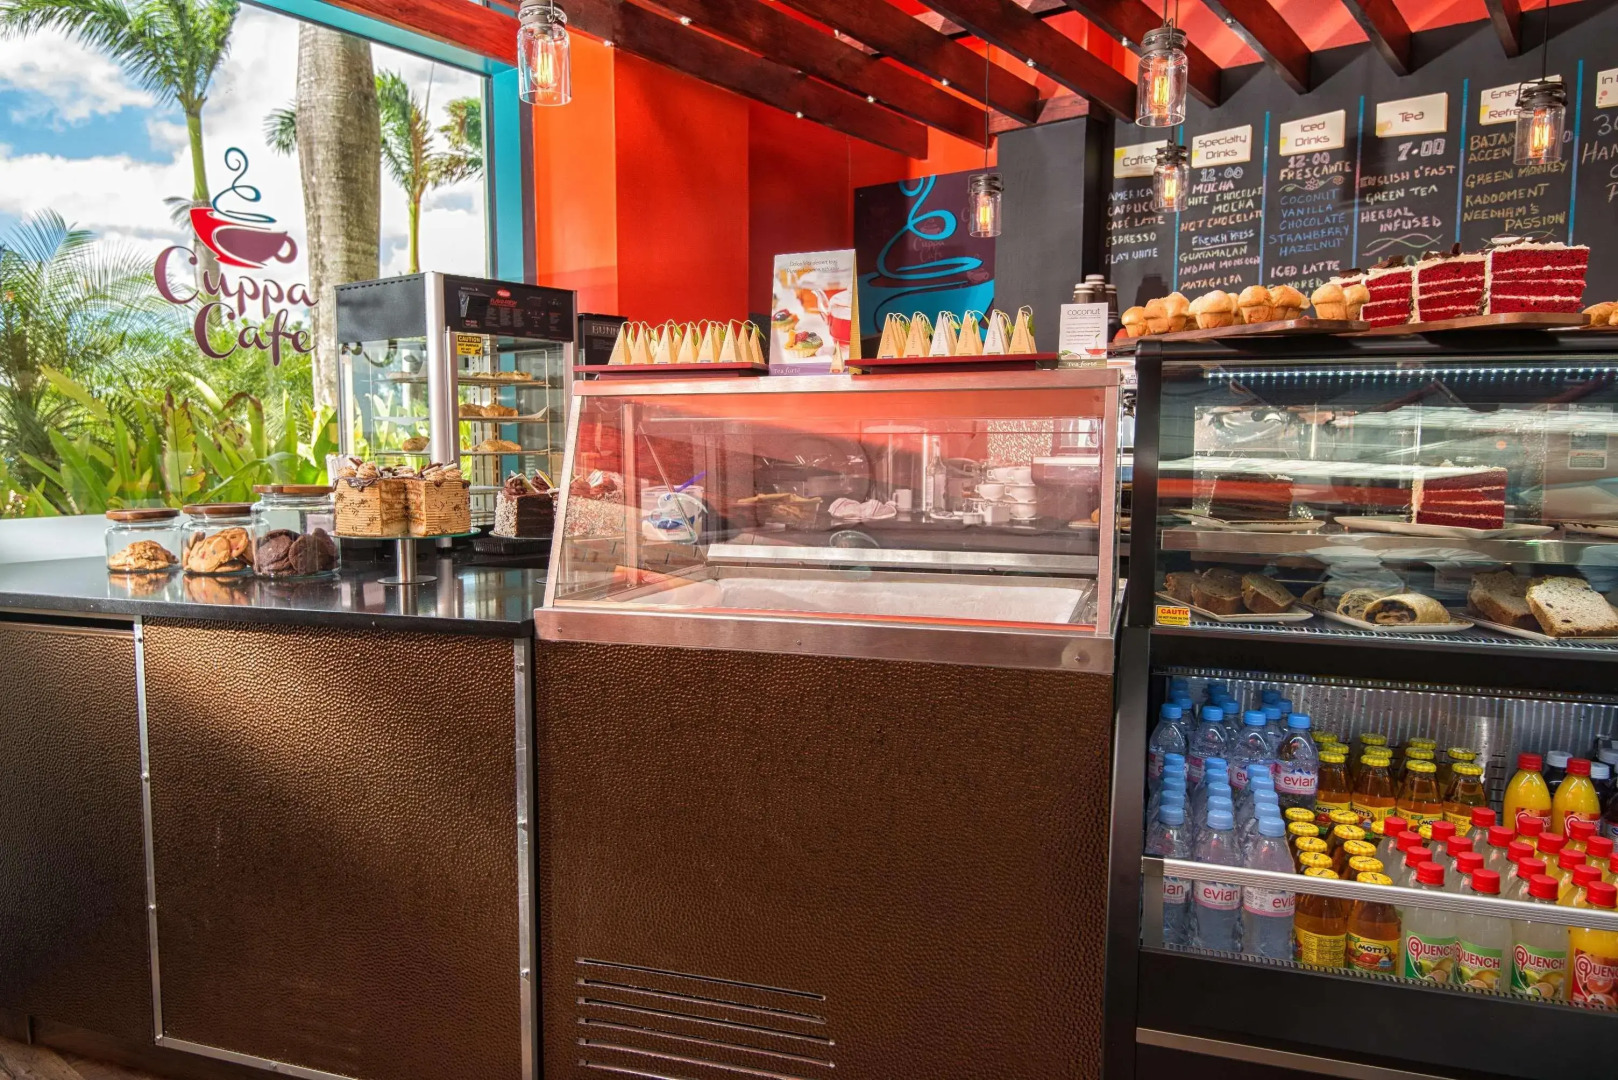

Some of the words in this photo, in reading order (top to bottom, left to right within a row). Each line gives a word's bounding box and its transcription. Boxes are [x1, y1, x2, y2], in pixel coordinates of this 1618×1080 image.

[1398, 111, 1424, 123] Tea
[1300, 121, 1325, 133] Iced
[1198, 134, 1247, 148] Specialty
[1295, 135, 1330, 147] Drinks
[1122, 154, 1157, 167] Coffee
[1205, 149, 1238, 160] Drinks
[1359, 170, 1410, 188] ENGLISH
[1465, 168, 1514, 189] GREEN
[1107, 187, 1154, 202] AMERICA
[1192, 180, 1234, 194] MOCHA
[1365, 188, 1406, 206] GREEN
[1409, 184, 1438, 197] TEA
[1465, 182, 1550, 208] KADOOMENT
[1187, 195, 1209, 206] HITE
[1280, 188, 1340, 206] COCONUT
[1212, 199, 1254, 215] MOCHA
[1281, 203, 1333, 219] VANILLA
[1279, 212, 1346, 231] CHOCOLATE
[1360, 207, 1414, 224] HERBAL
[1505, 211, 1566, 232] PASSION
[1180, 219, 1205, 232] HOT
[1379, 215, 1442, 233] INFUSED
[1105, 231, 1157, 248] ESPRESSO
[1268, 224, 1350, 245] STRAWBERRY
[1279, 238, 1345, 257] HAZELNUT
[1270, 264, 1298, 278] ICED
[1302, 260, 1340, 275] LATTE
[154, 245, 319, 320] Cuppa
[1066, 308, 1101, 316] coconut
[193, 302, 317, 367] Cafe
[1283, 775, 1315, 787] evian
[1163, 881, 1185, 895] ian
[1203, 887, 1238, 902] evian
[1357, 943, 1389, 954] MOTT'S
[1514, 944, 1566, 971] QUENCH
